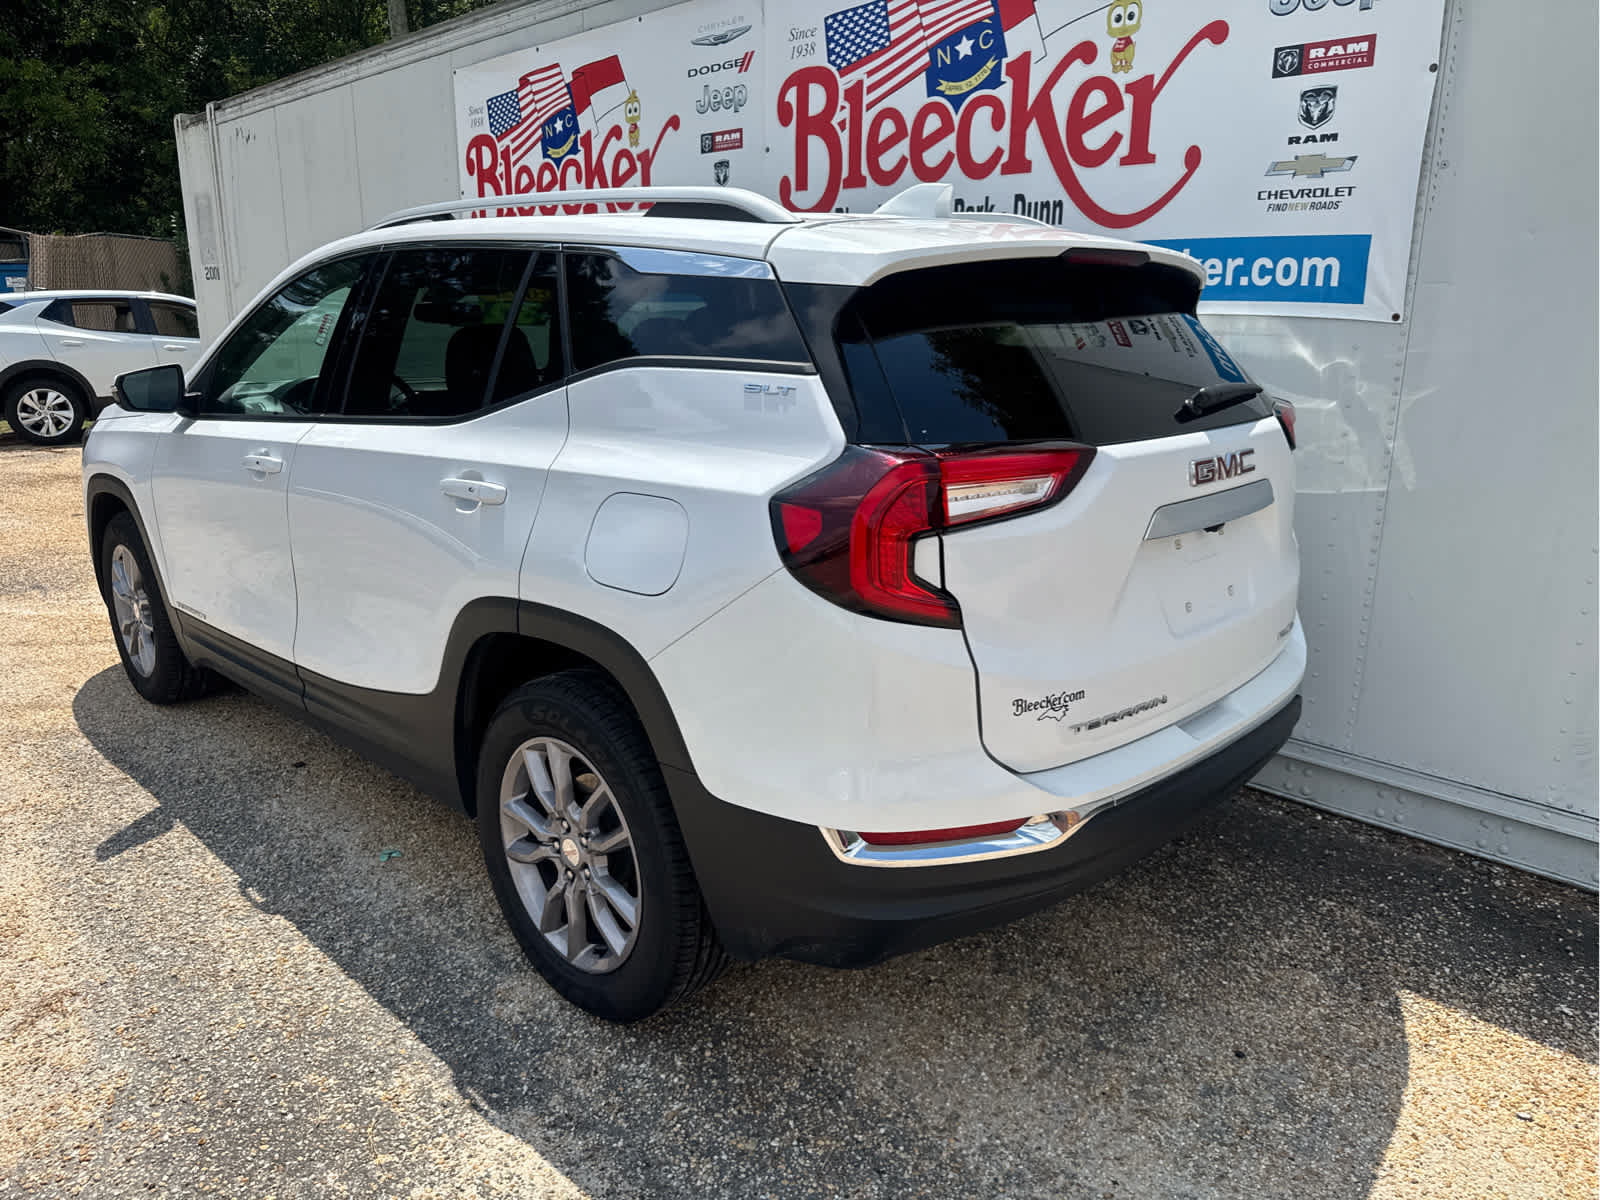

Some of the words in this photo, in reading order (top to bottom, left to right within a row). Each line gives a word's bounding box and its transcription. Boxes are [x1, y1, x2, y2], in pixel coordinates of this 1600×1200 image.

[789, 27, 817, 42] Since
[791, 41, 816, 59] 1938
[937, 45, 951, 68] N
[979, 29, 994, 49] C
[1309, 41, 1369, 59] RAM
[688, 57, 746, 78] DODGE
[1308, 57, 1368, 70] COMMERCIAL
[696, 84, 748, 114] Jeep
[1287, 132, 1339, 145] RAM
[1257, 186, 1356, 201] CHEVROLET
[1013, 193, 1063, 225] Dunn
[1198, 256, 1340, 288] er.com
[743, 383, 797, 396] SLT
[1189, 447, 1256, 487] GMC
[1068, 694, 1168, 734] TERRAIN
